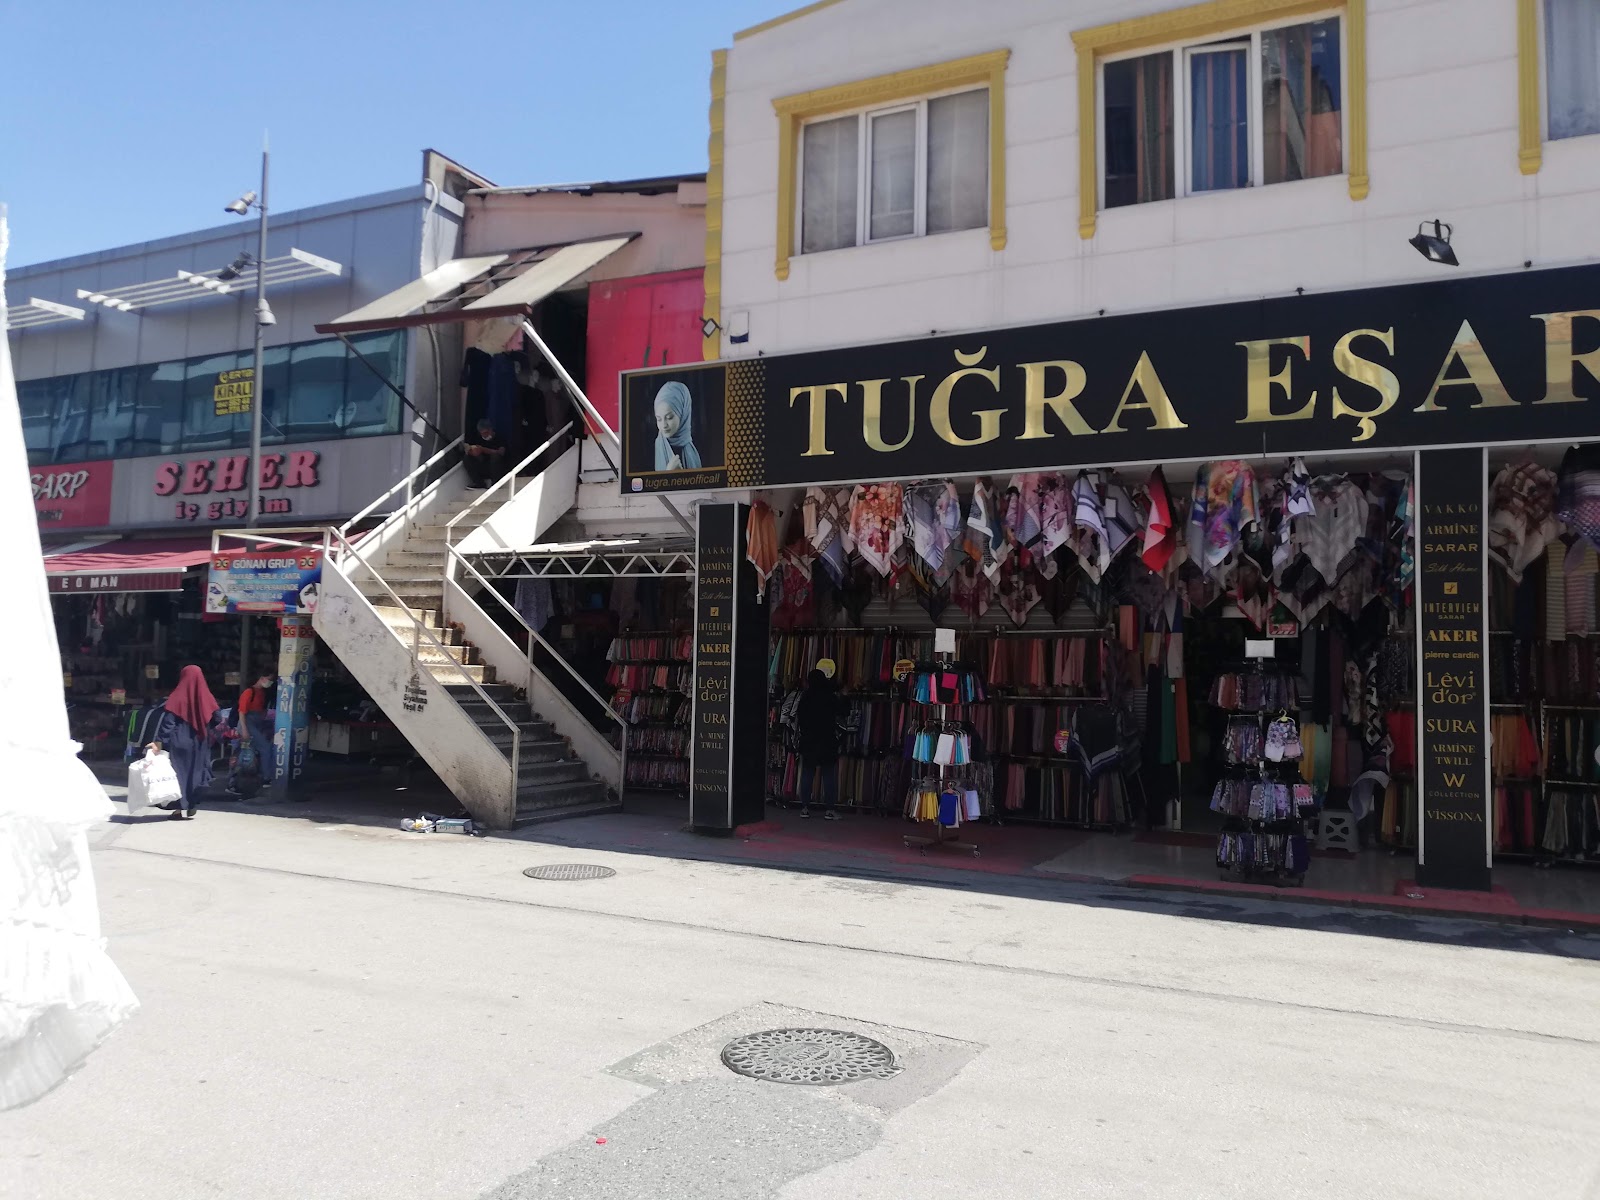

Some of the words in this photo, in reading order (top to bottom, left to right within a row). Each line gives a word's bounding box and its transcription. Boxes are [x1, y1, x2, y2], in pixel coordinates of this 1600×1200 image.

[789, 345, 1189, 456] TUĞRA
[153, 451, 319, 496] SEHER
[175, 501, 199, 521] iç
[1424, 503, 1478, 513] VAKKO
[1424, 543, 1478, 553] SARAR
[268, 558, 296, 569] GRUP
[700, 577, 732, 585] SARAR
[1425, 602, 1479, 613] INTERVIEW
[1425, 630, 1479, 642] AKER
[699, 643, 731, 653] AKER
[1425, 650, 1449, 659] pierre
[1452, 651, 1480, 659] cardin
[1426, 719, 1478, 733] SURA
[1434, 756, 1472, 766] TWILL
[1428, 791, 1480, 799] COLLECTION
